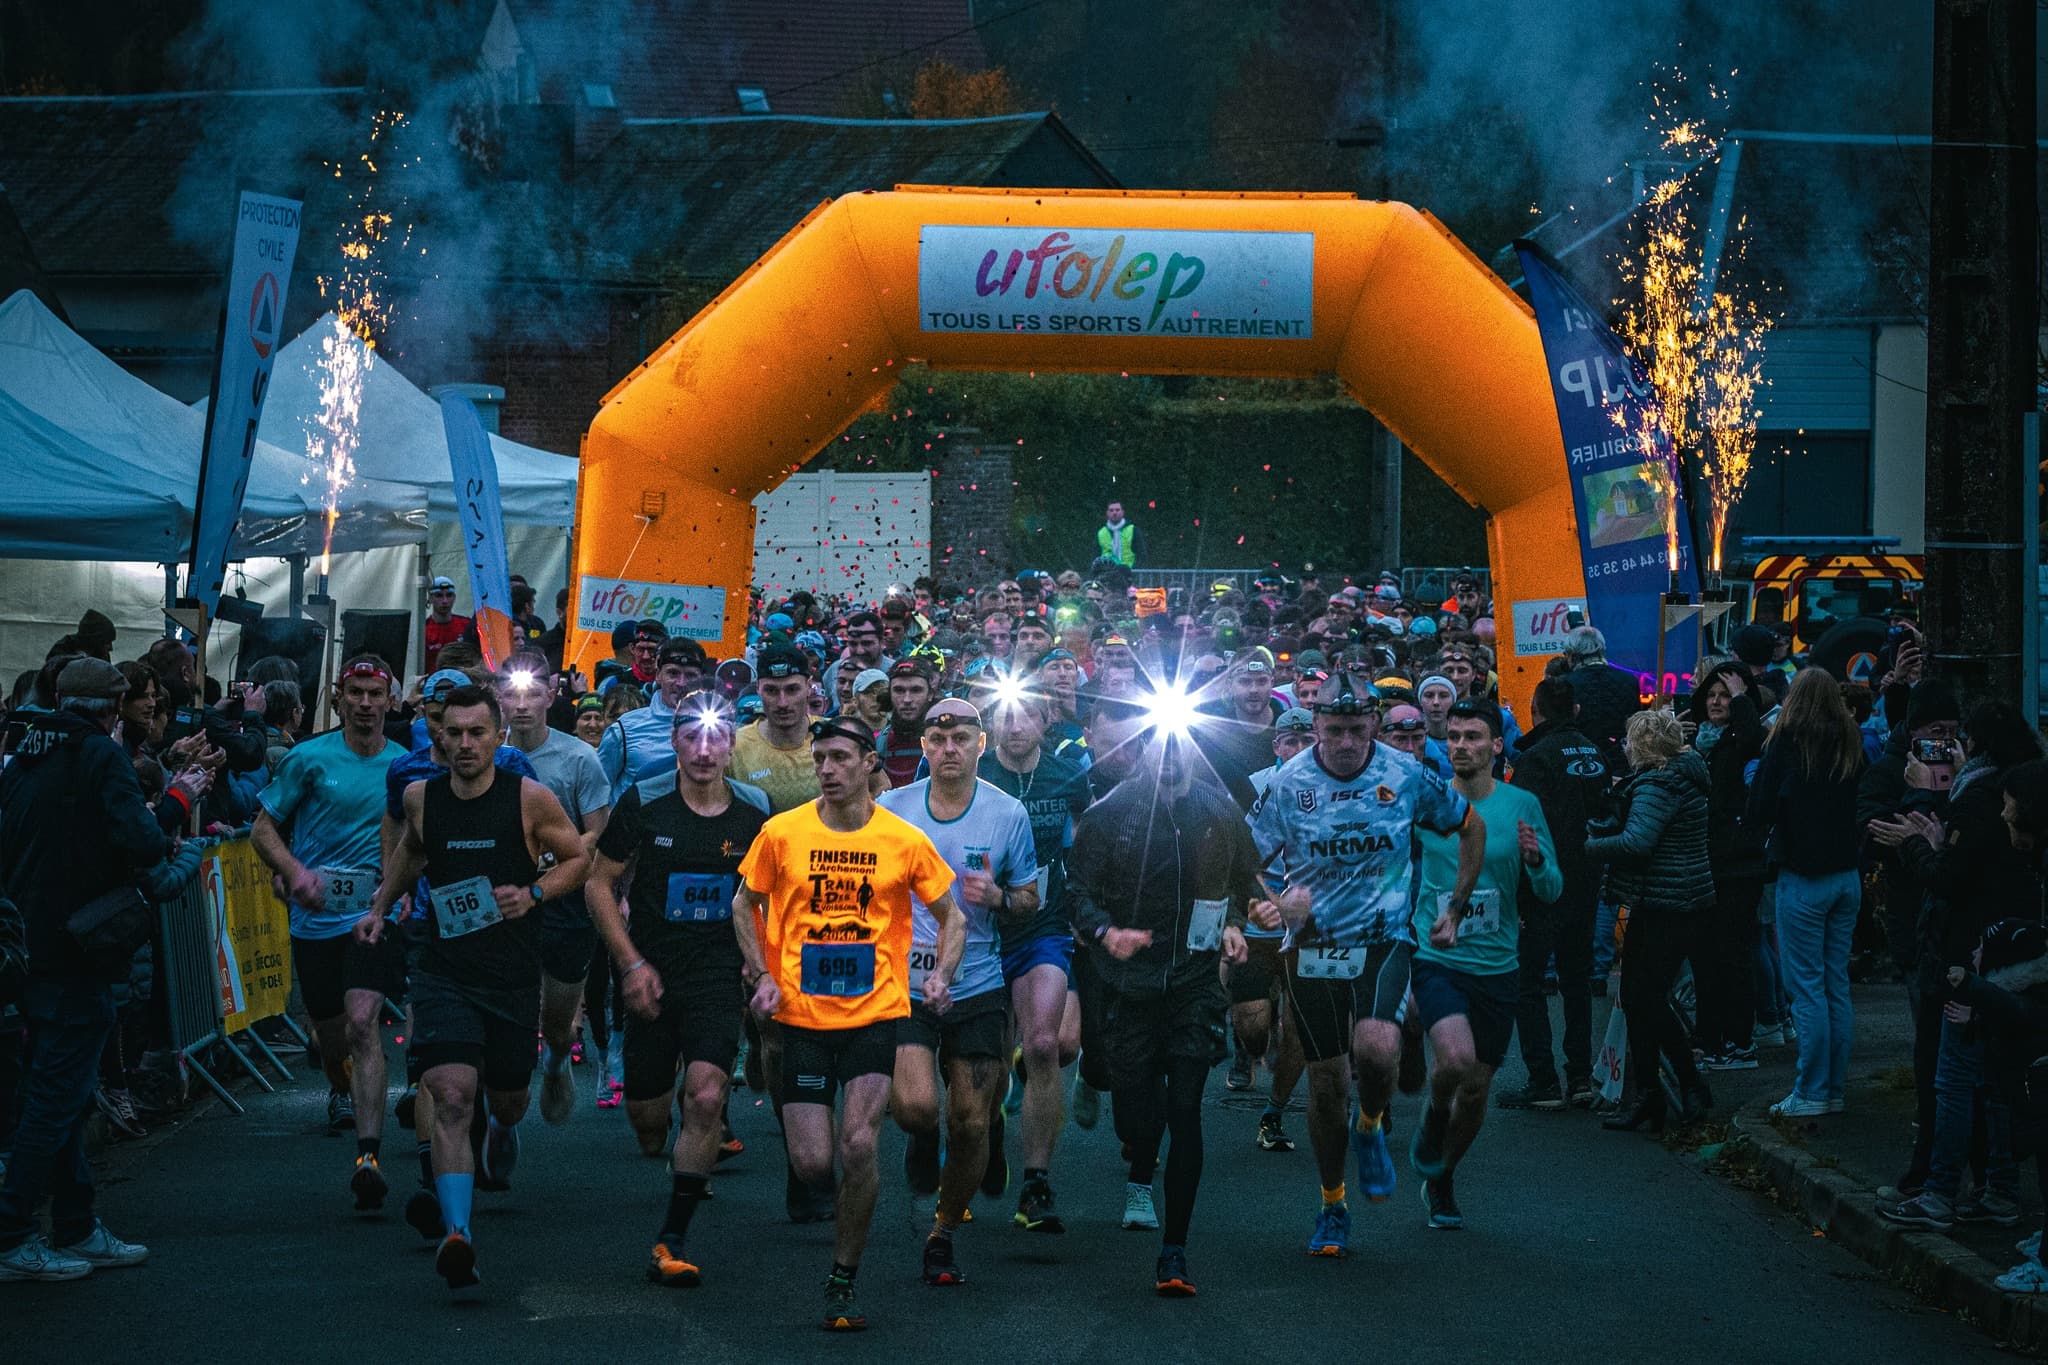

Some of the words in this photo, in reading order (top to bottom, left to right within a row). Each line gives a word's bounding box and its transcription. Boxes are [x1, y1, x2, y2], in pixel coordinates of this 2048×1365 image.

[241, 201, 300, 229] PROTECTION
[258, 239, 285, 262] CIVILE
[976, 232, 1206, 330] ufolep
[928, 312, 990, 330] TOUS
[999, 314, 1042, 331] LES
[1048, 315, 1142, 333] SPORTS
[1161, 317, 1305, 337] AUTREMENT
[591, 583, 685, 623] ufolep
[579, 616, 596, 627] TOUS
[596, 619, 613, 629] LES
[666, 626, 720, 638] UTREMENT
[1517, 643, 1538, 652] TOUS
[1539, 641, 1558, 651] LES
[1330, 789, 1365, 802] ISC
[446, 839, 497, 850] PROZIS
[1310, 835, 1395, 858] NRMA
[809, 850, 878, 866] FINISHER
[1319, 866, 1386, 881] INSURANCE
[332, 879, 355, 896] 33
[684, 886, 721, 904] 644
[445, 892, 480, 917] 156
[818, 957, 858, 977] 695
